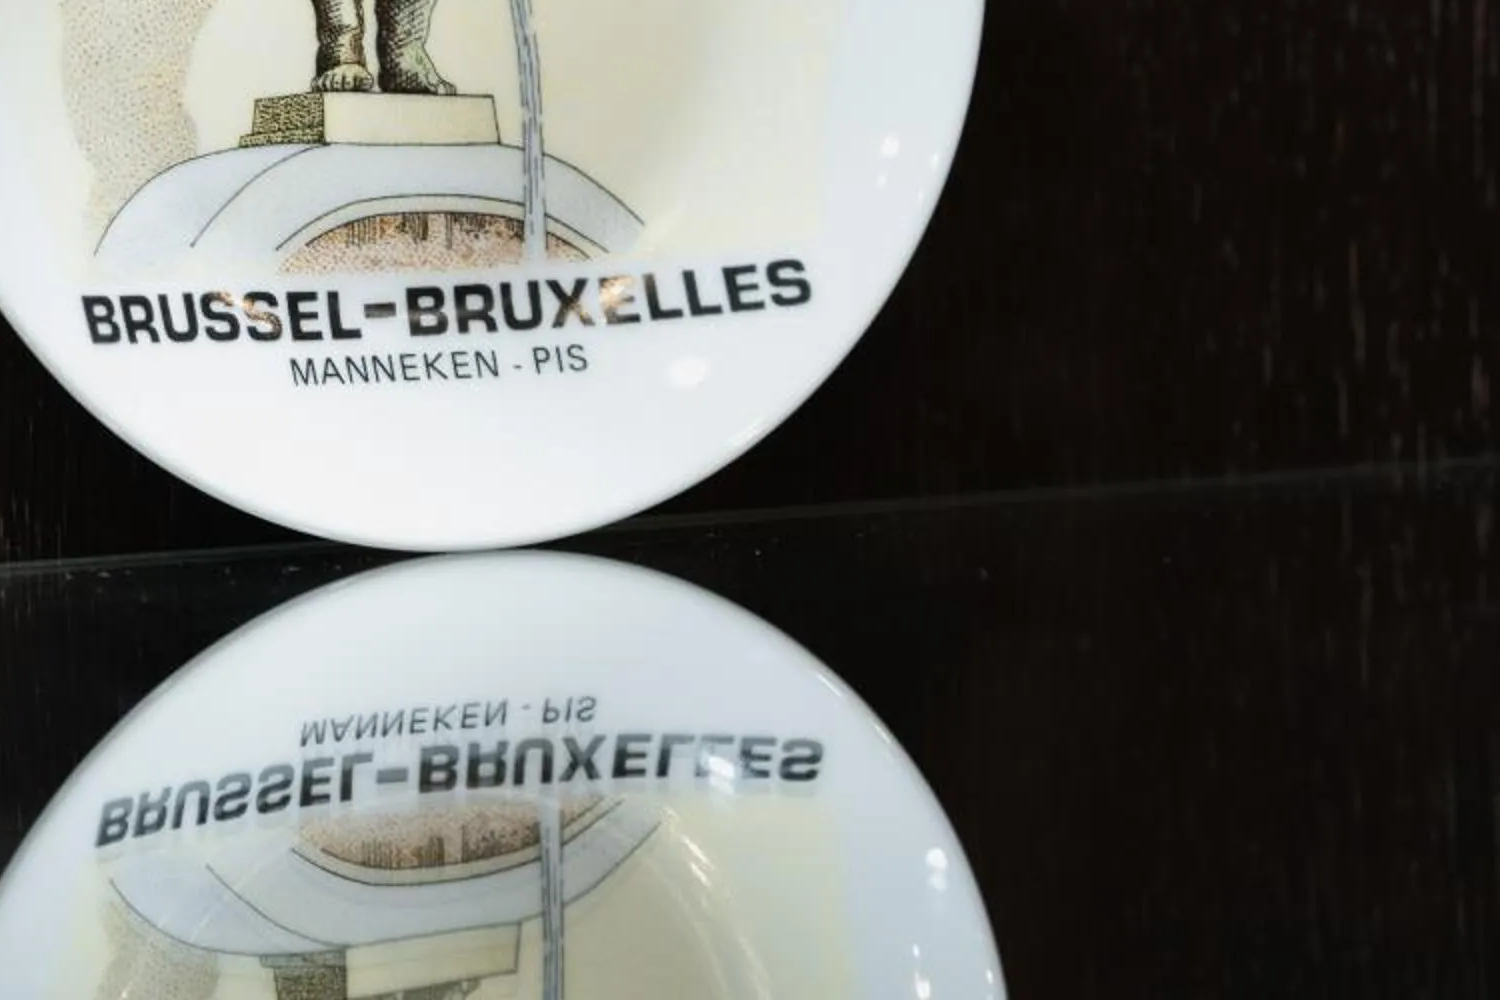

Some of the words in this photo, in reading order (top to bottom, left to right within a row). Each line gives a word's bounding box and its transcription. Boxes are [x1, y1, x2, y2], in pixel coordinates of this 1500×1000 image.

[82, 259, 812, 344] BRUSSEL-BRUXELLES
[290, 348, 499, 387] MANNEKEN
[532, 345, 588, 375] PIS
